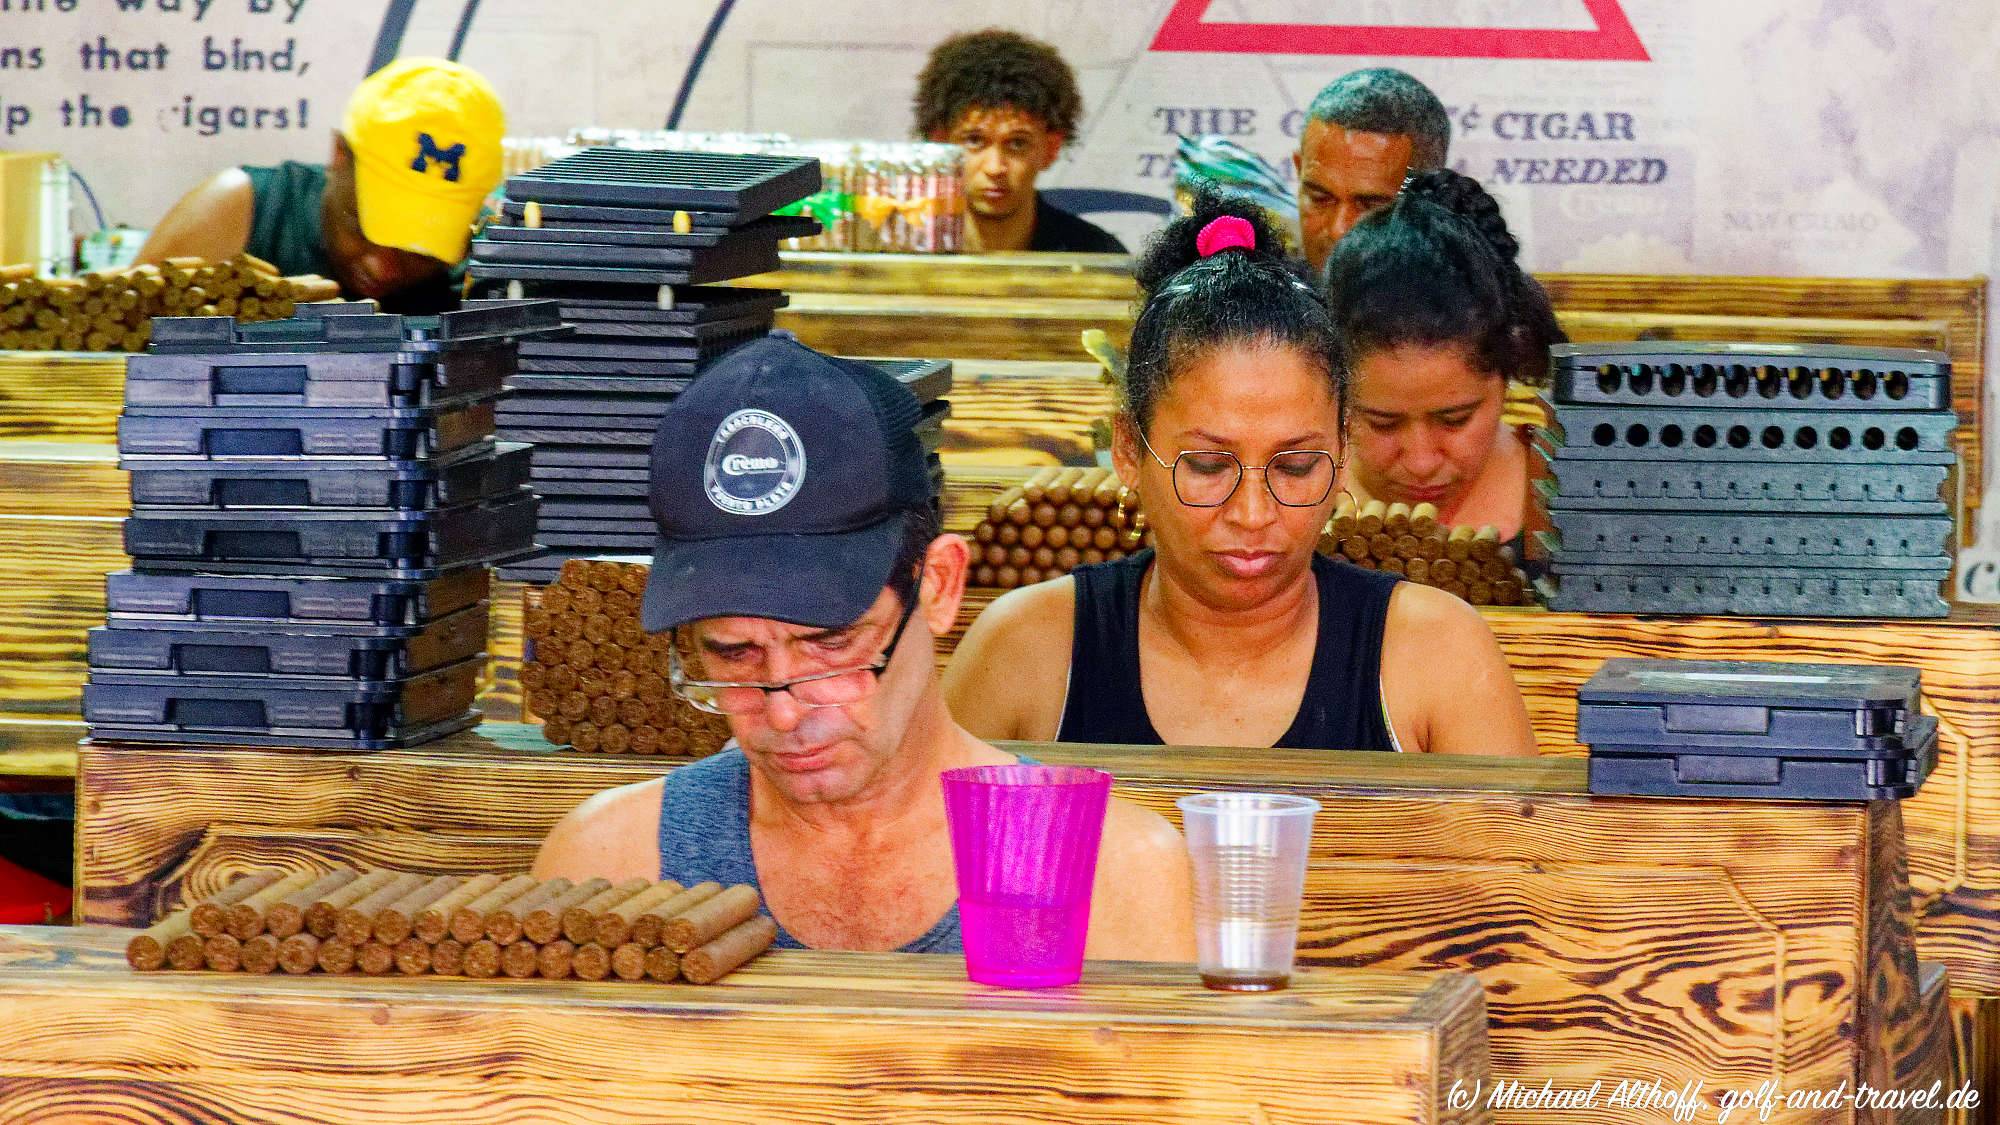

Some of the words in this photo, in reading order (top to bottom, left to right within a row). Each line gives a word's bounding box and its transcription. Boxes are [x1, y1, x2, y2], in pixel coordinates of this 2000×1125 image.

[80, 35, 169, 71] that
[203, 36, 309, 77] bind,
[1154, 106, 1256, 137] THE
[1493, 111, 1636, 141] CIGAR
[411, 132, 466, 183] M
[1486, 157, 1669, 185] NEEDED
[1963, 561, 2000, 597] C
